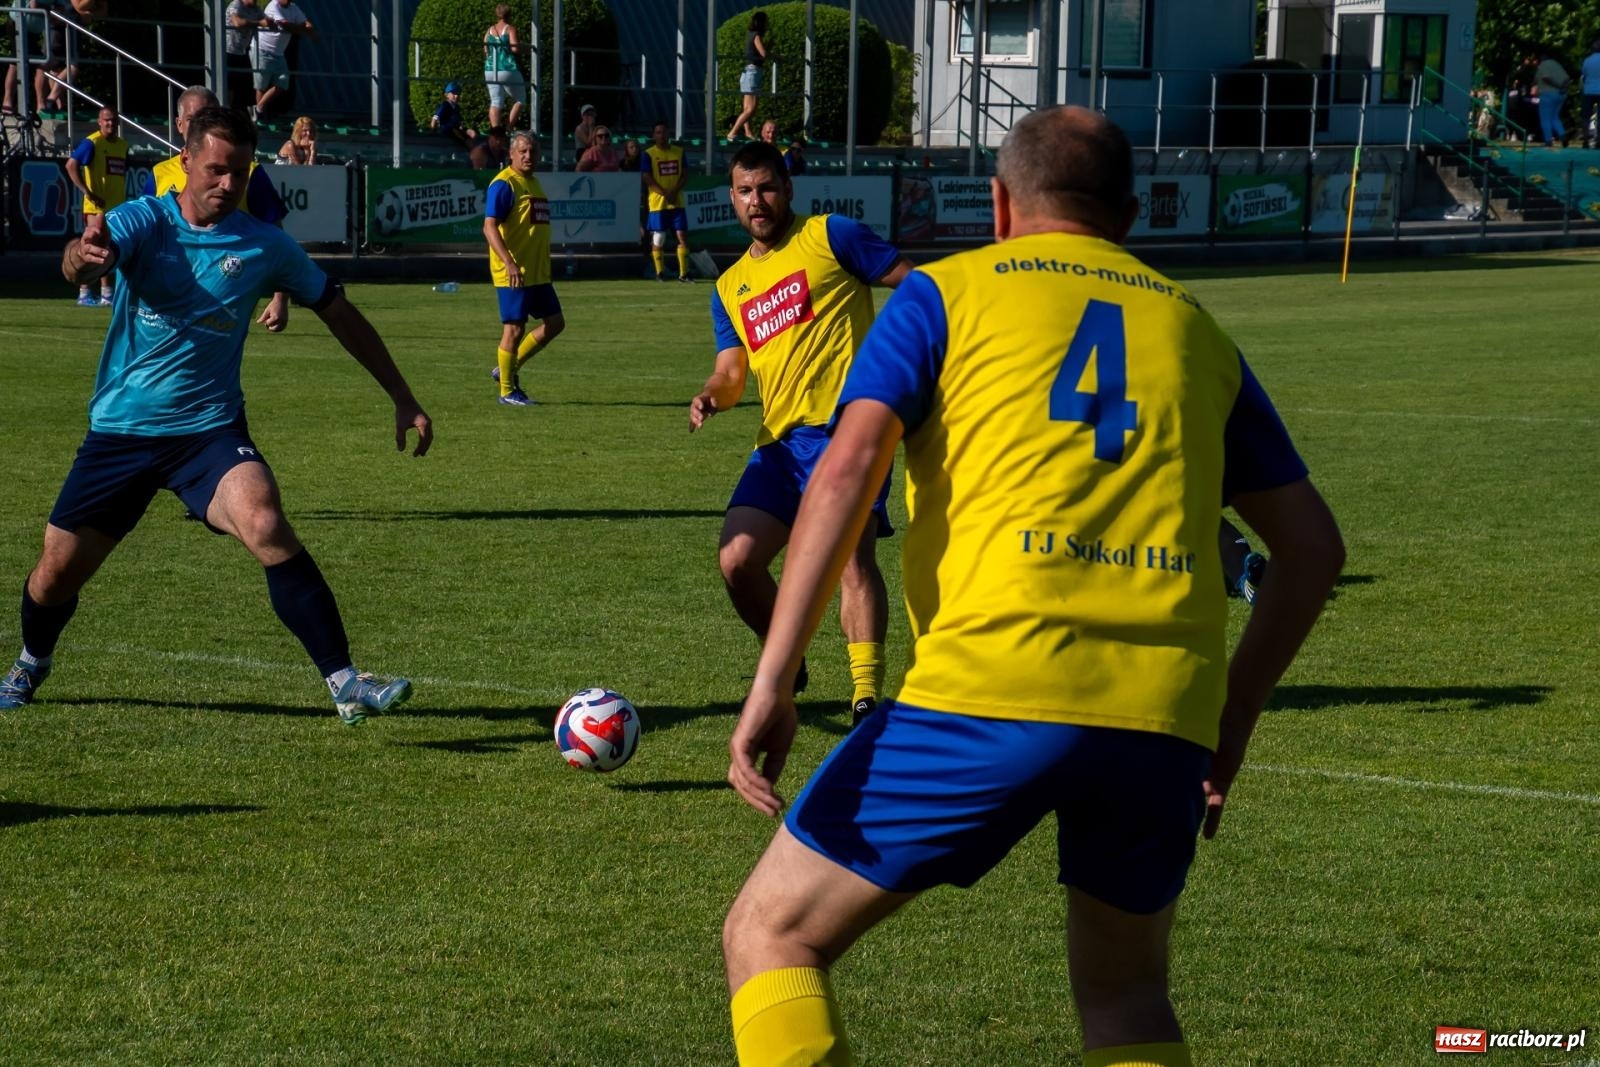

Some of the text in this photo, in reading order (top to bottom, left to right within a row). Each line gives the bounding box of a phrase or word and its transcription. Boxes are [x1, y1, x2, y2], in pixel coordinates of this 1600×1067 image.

[405, 184, 452, 201] IRENEUSZ
[406, 196, 477, 222] WSZOŁEK
[687, 191, 718, 205] DANIEL
[747, 281, 801, 321] elektro
[753, 302, 803, 342] Müller
[1048, 298, 1138, 465] 4
[1017, 530, 1056, 554] TJ
[1064, 533, 1136, 567] Sokol
